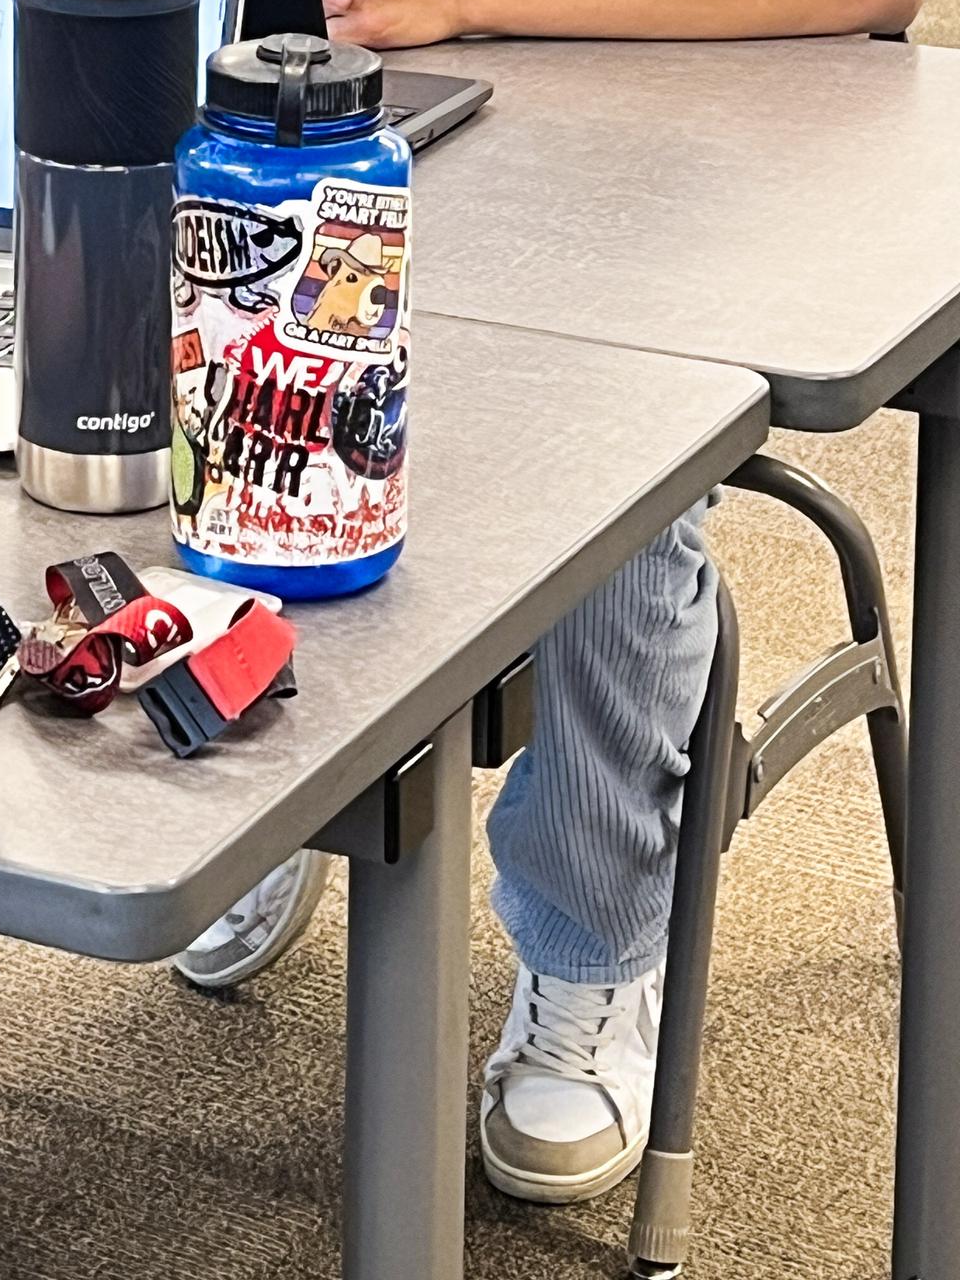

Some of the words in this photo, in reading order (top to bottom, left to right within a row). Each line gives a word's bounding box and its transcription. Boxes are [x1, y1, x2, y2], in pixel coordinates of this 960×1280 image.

[318, 202, 379, 226] SMART
[286, 323, 307, 339] OR
[307, 329, 321, 343] A
[321, 331, 355, 350] FART
[76, 412, 153, 434] contigo
